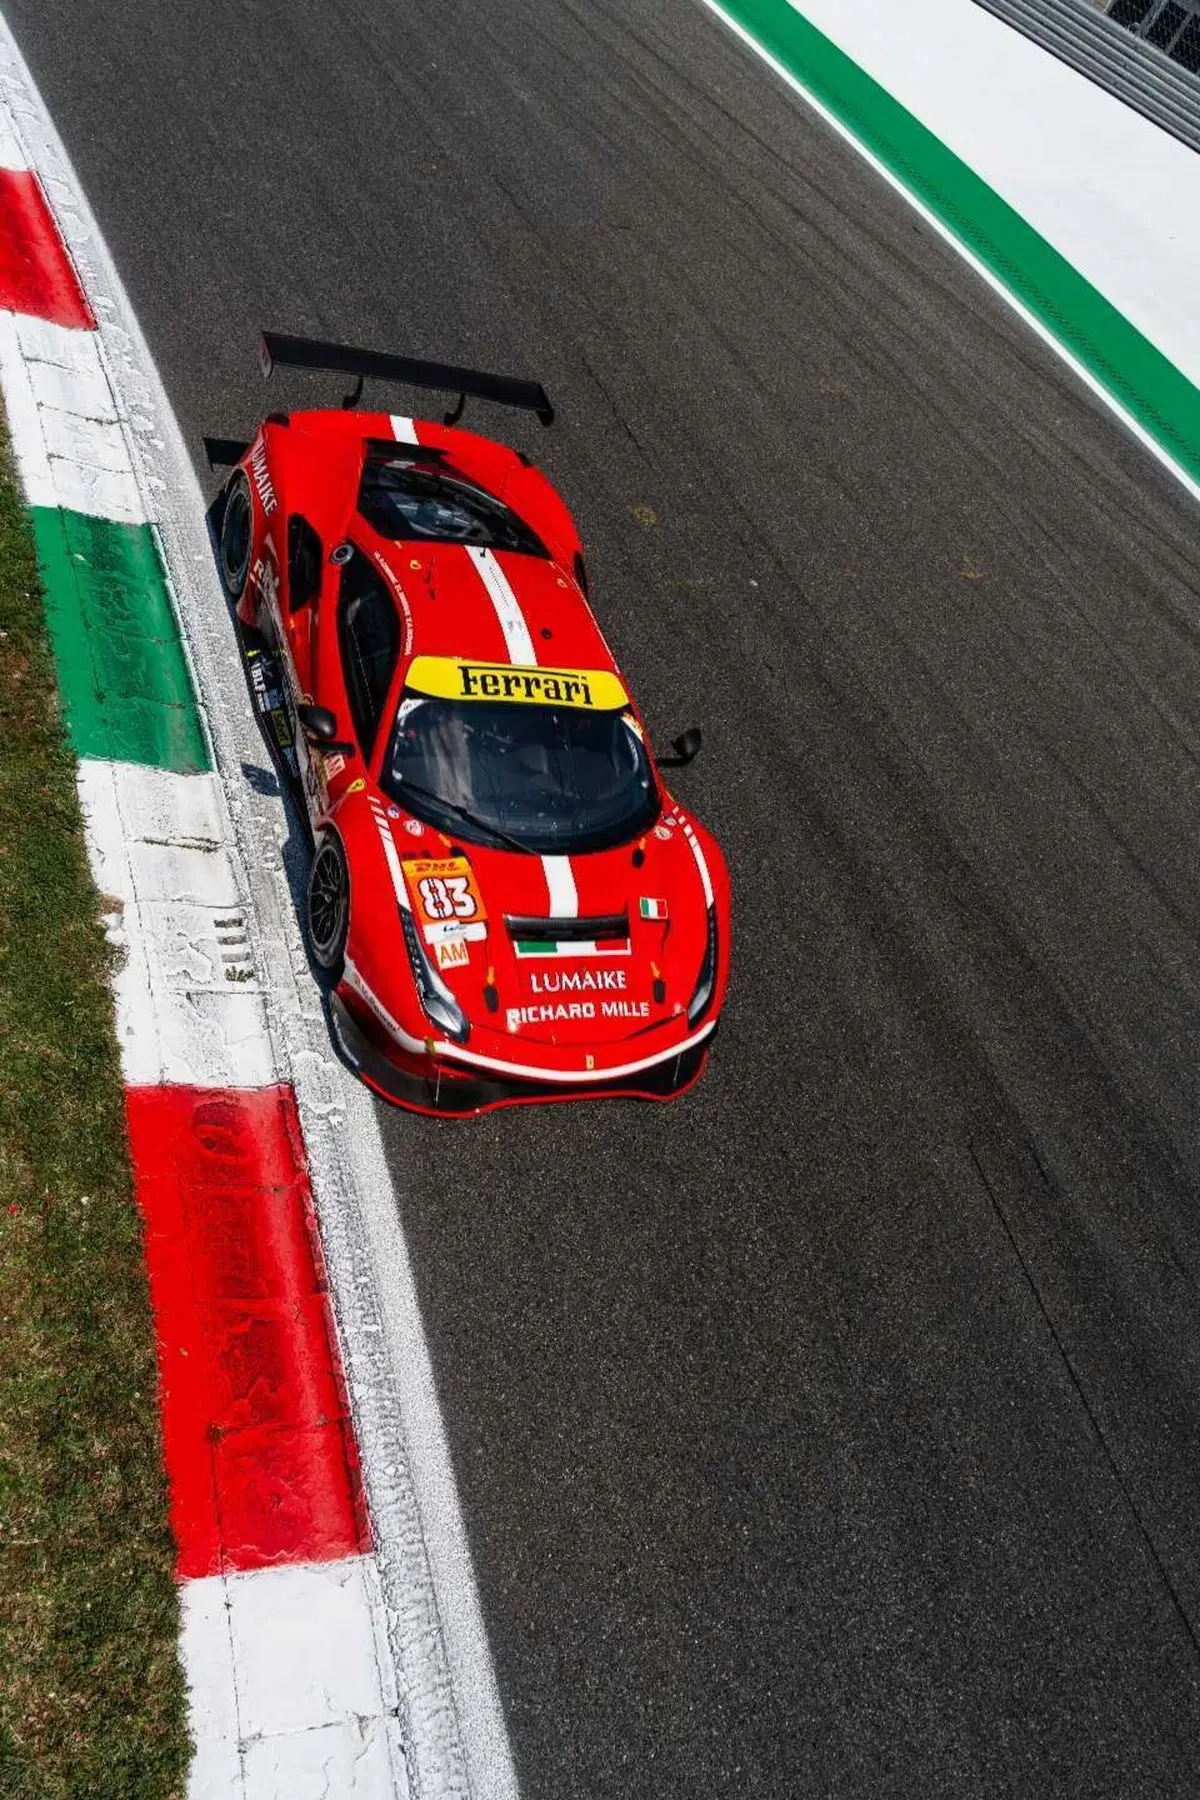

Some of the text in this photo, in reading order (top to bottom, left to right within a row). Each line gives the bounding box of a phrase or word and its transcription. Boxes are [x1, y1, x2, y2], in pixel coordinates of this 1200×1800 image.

[457, 665, 593, 706] Ferrari
[418, 876, 478, 920] 83
[440, 942, 468, 964] AM
[531, 970, 627, 994] LUMAIKE
[506, 1001, 650, 1026] RICHARD MILLE
